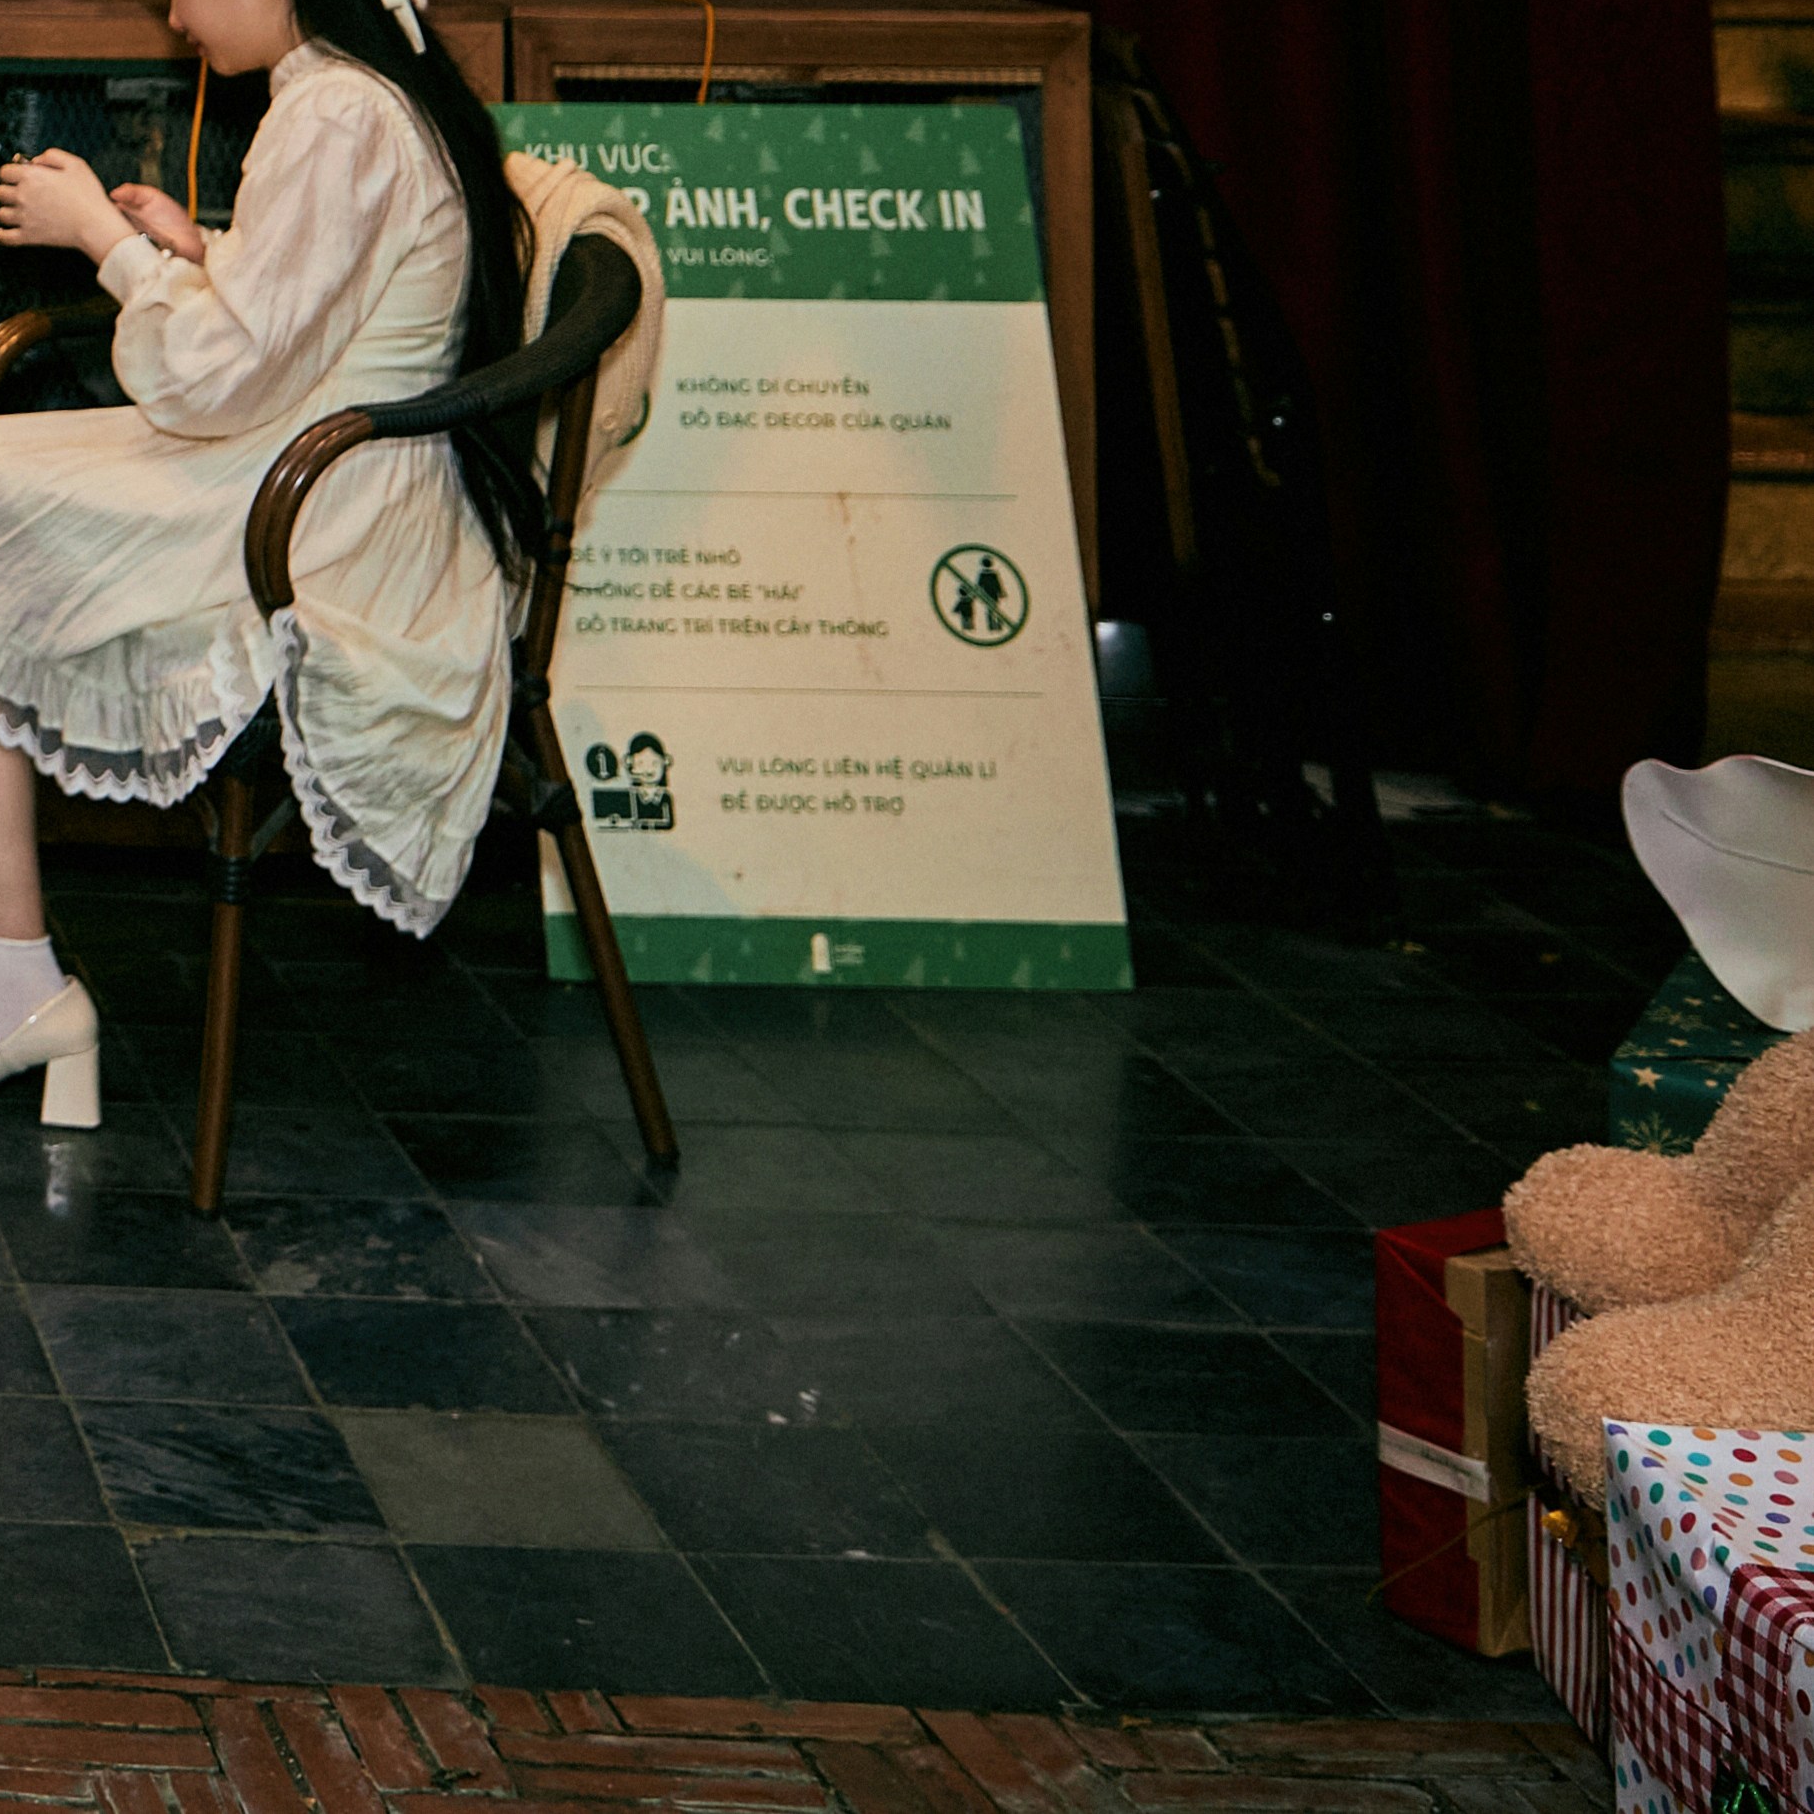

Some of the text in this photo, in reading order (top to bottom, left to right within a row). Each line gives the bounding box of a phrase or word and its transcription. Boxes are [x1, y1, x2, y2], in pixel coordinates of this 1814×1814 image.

[665, 177, 772, 233] ẢNH,
[783, 187, 928, 231] CHECK
[938, 189, 986, 231] IN
[667, 248, 704, 266] VUI
[676, 375, 750, 395] KHÔNG
[764, 411, 835, 429] DECOR
[611, 617, 677, 634] TRANG
[717, 757, 753, 776] VUI
